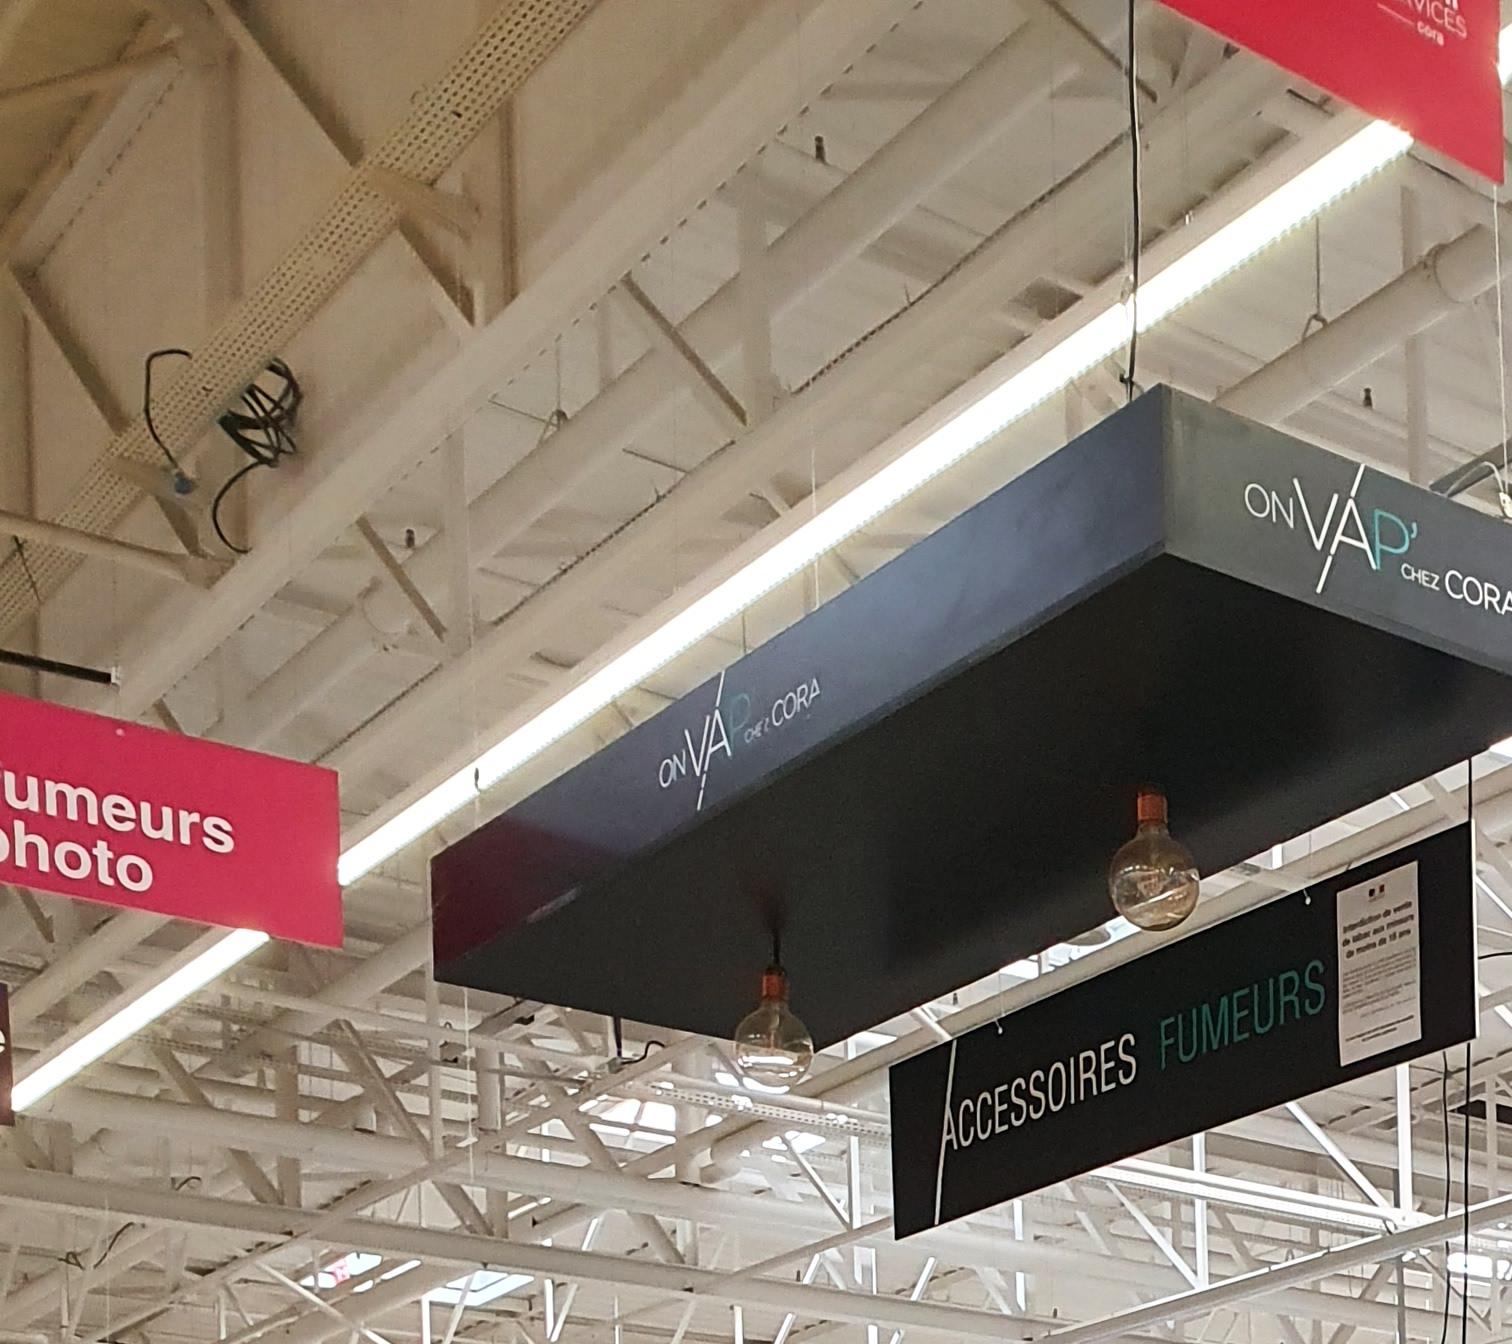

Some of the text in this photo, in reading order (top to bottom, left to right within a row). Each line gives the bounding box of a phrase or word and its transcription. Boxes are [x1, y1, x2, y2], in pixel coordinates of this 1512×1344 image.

[1245, 482, 1295, 530] ON
[1400, 563, 1440, 592] CHEZ
[658, 748, 687, 789] ON
[771, 677, 821, 728] CORA
[0, 769, 236, 855] umeurs
[942, 1032, 1138, 1153] ACCESSOIRES
[1160, 959, 1327, 1071] FUMEURS
